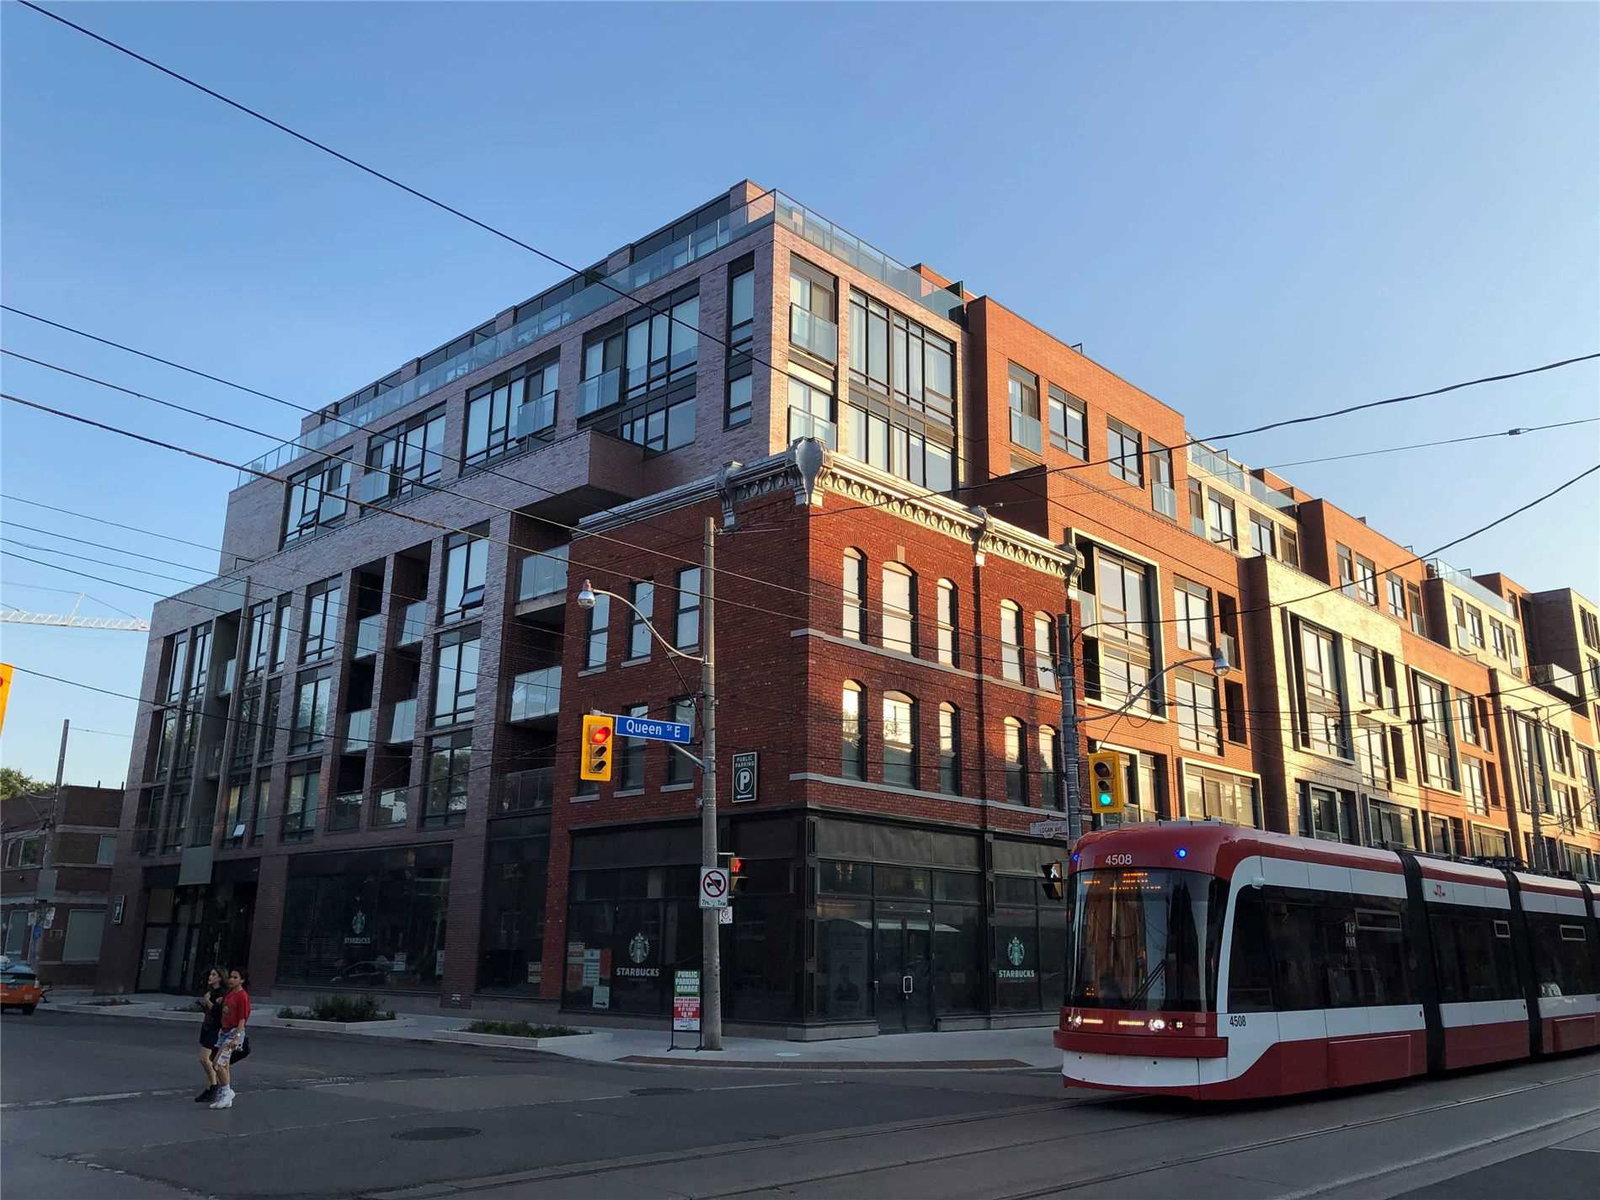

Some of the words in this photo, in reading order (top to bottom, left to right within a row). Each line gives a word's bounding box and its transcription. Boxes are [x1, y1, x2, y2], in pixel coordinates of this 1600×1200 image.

[626, 720, 661, 735] Queen
[675, 726, 680, 738] E
[740, 771, 750, 790] P
[1105, 854, 1132, 865] 4508
[616, 967, 660, 977] STARBUCKS
[677, 970, 698, 978] PUBLIC
[998, 969, 1035, 978] STARBUCKS
[676, 985, 698, 993] GARAGE
[1229, 1015, 1247, 1027] 4508
